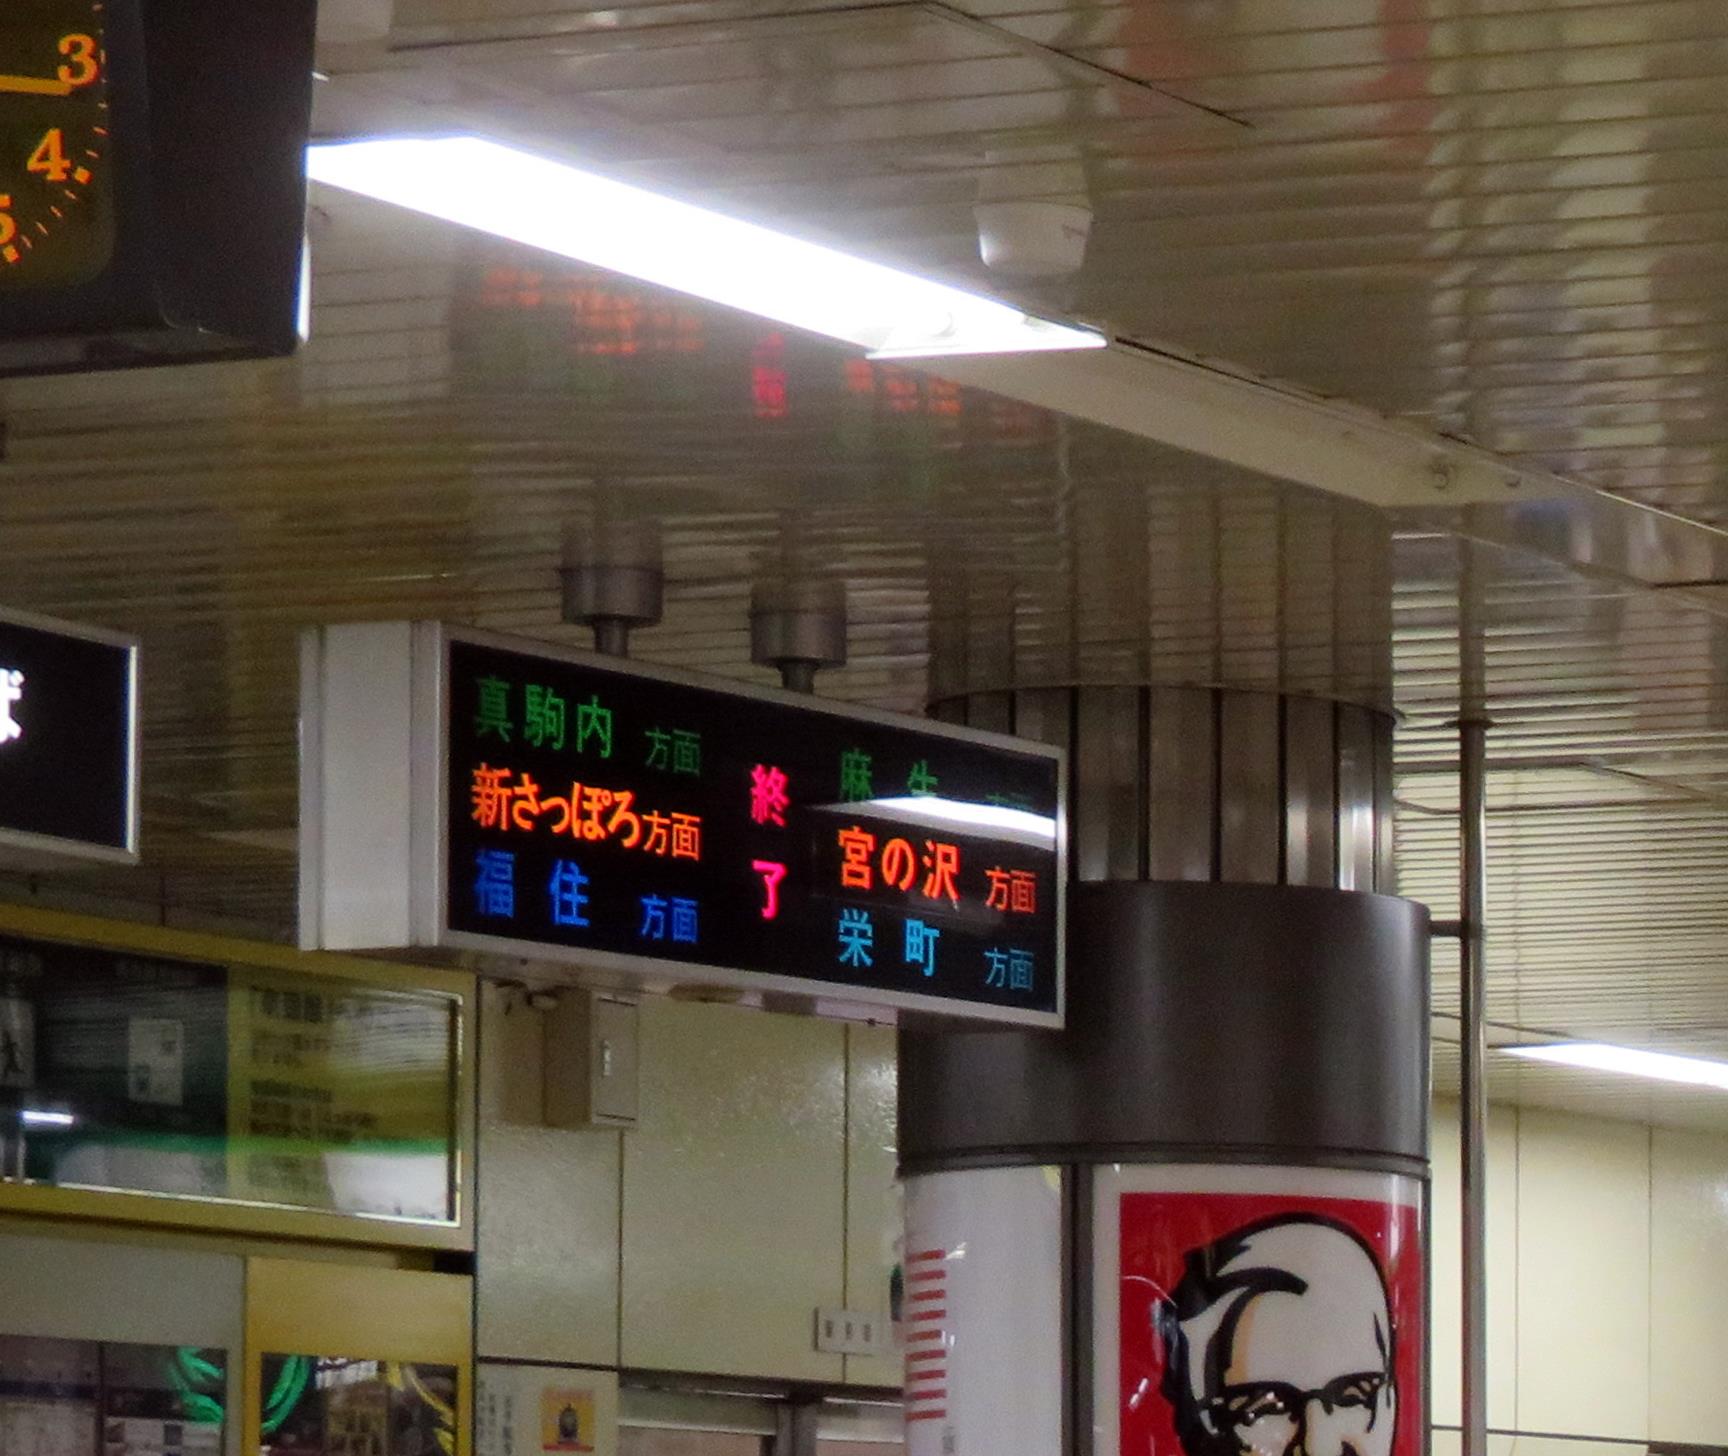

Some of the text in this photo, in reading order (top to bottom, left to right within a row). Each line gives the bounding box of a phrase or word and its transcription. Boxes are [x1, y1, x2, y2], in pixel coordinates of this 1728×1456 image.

[57, 33, 100, 86] 3
[27, 127, 72, 182] 4
[475, 676, 701, 777] 真駒内 方面
[471, 762, 701, 861] 新さっぽろ 方面
[750, 763, 790, 921] 終了
[474, 849, 700, 945] 福住 方面
[837, 825, 1037, 915] 宮の沢 方面
[837, 906, 1036, 993] 栄町 方面
